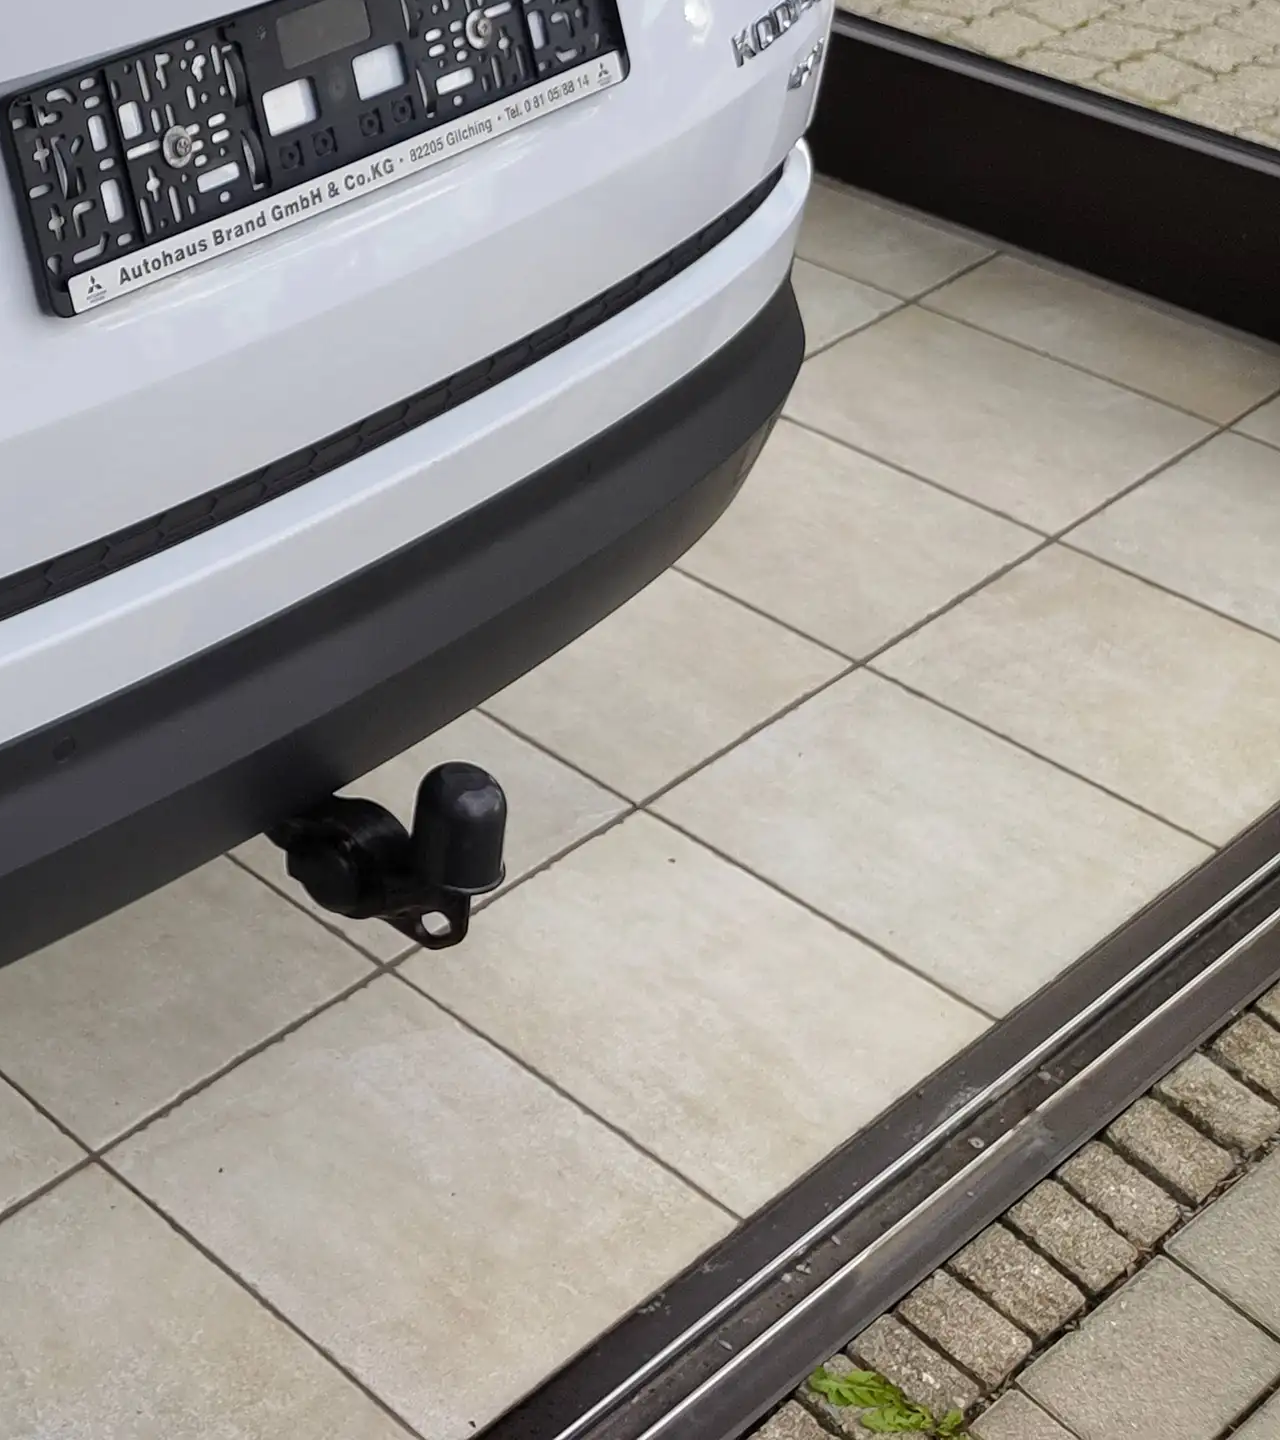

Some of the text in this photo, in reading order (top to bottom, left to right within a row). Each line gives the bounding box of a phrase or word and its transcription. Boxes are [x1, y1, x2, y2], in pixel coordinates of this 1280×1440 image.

[118, 238, 208, 286] Autohaus
[211, 211, 267, 246] Brand
[271, 187, 323, 222] GmbH
[327, 181, 341, 199] &
[344, 158, 395, 190] Co.KG
[409, 137, 444, 162] 82205
[446, 119, 493, 147] Gilching
[504, 104, 523, 121] Tel.
